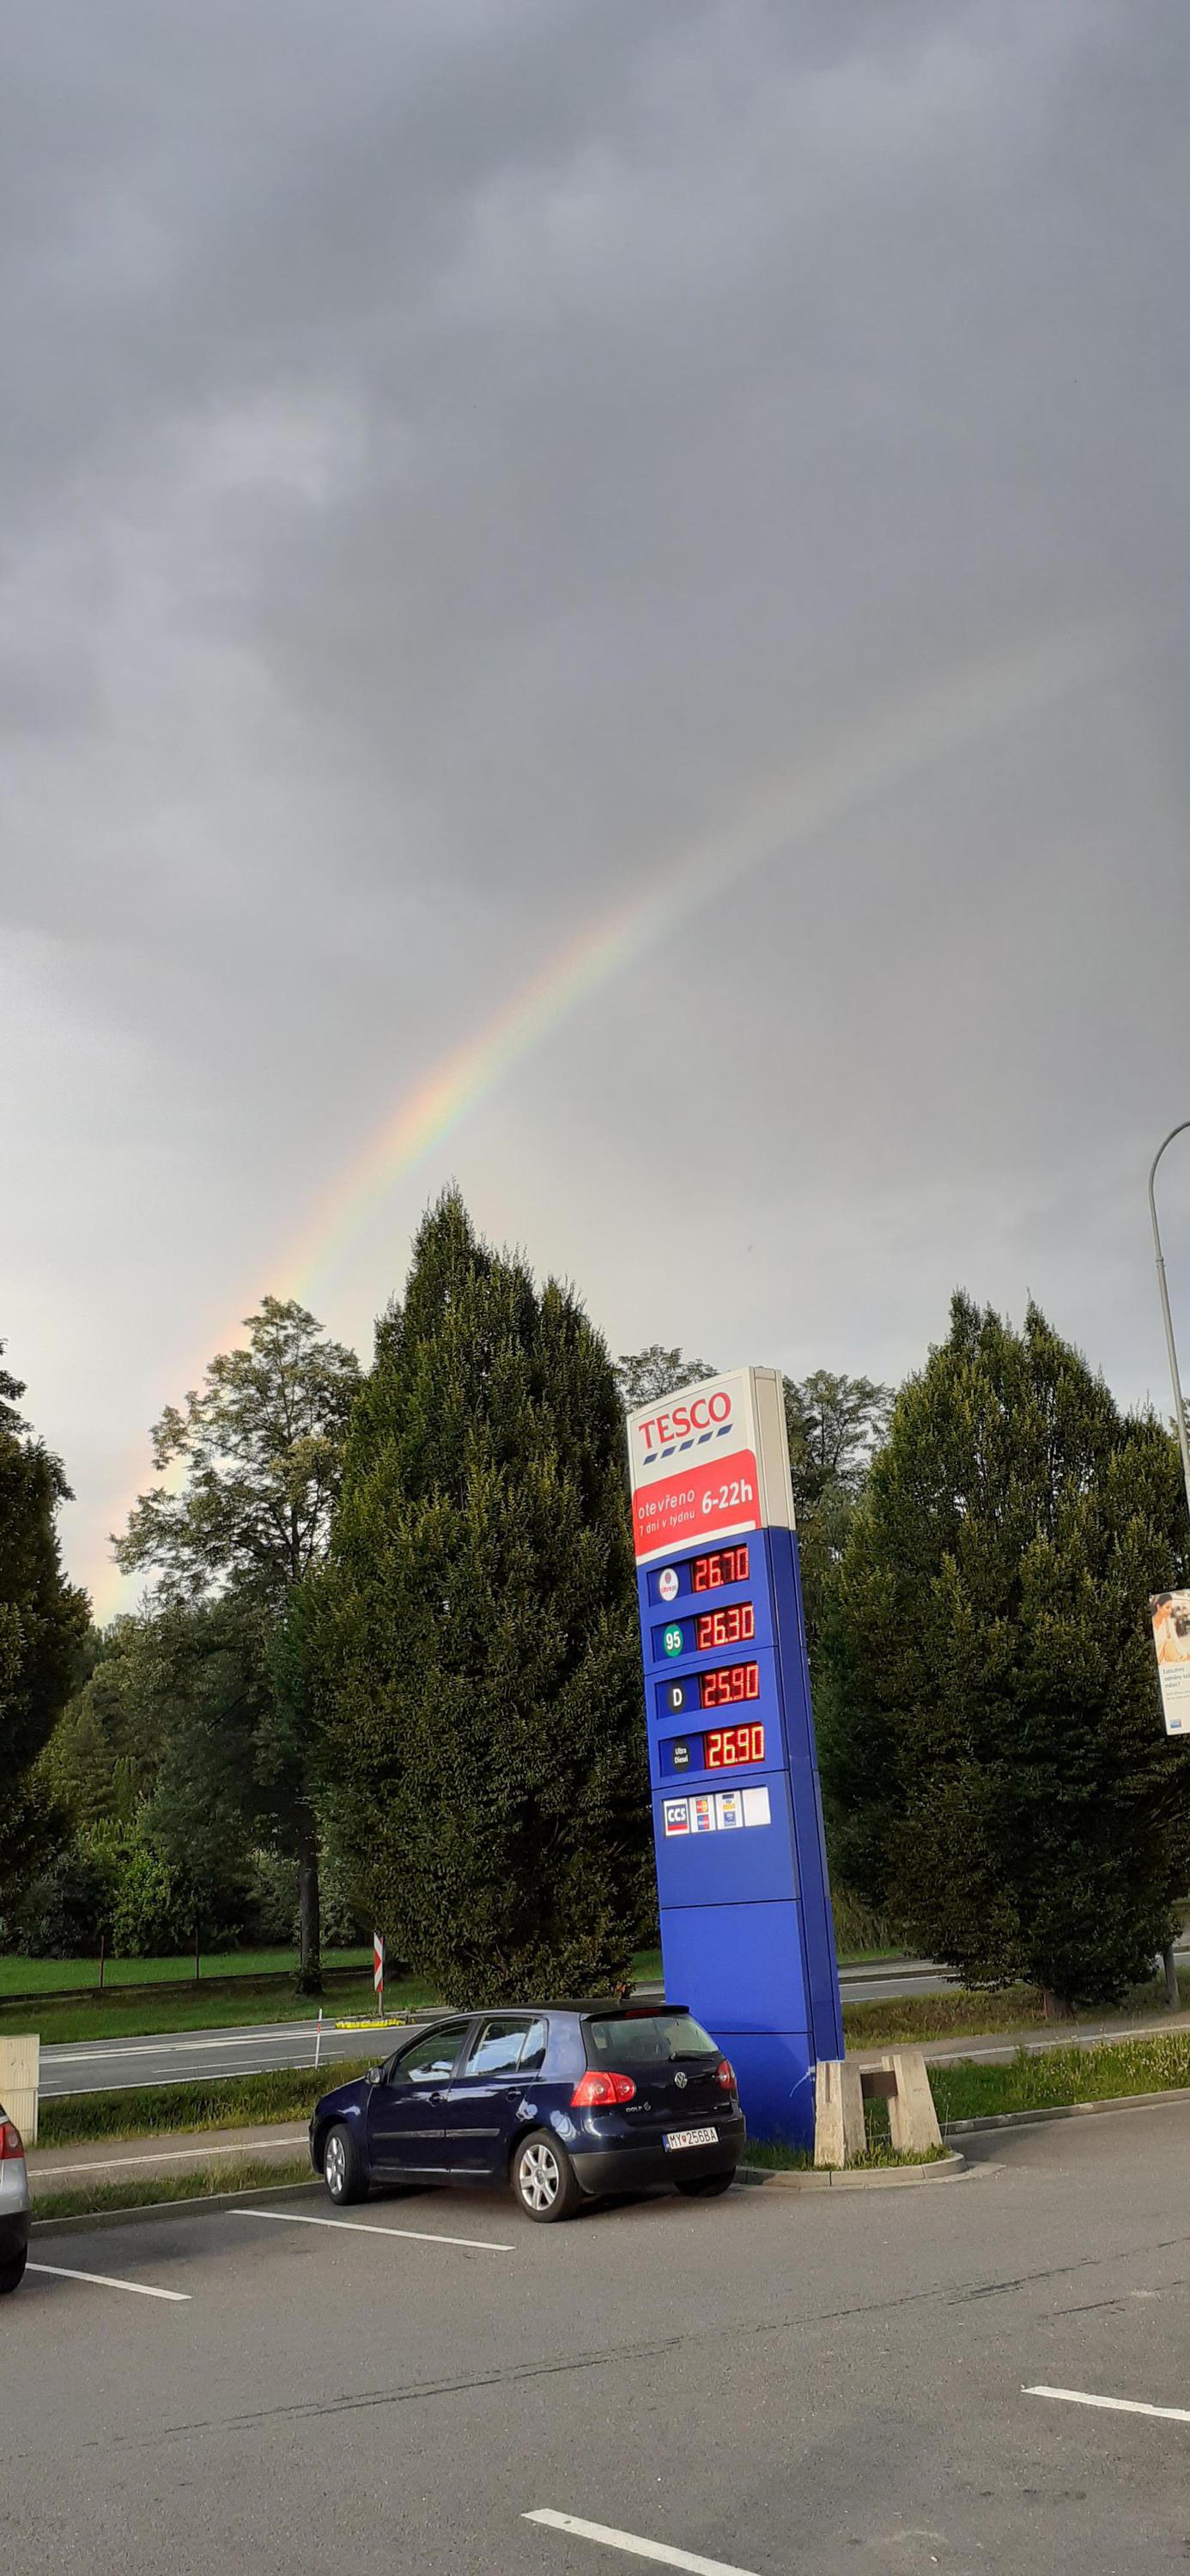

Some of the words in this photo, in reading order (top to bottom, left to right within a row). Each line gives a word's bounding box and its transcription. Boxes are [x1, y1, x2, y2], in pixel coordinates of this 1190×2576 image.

[639, 1392, 732, 1449] TESCO
[638, 1489, 695, 1520] otevřeno
[701, 1479, 753, 1515] 6-22h
[695, 1547, 750, 1591] 26.70
[665, 1630, 682, 1650] 95
[700, 1605, 755, 1649] 26.30
[672, 1687, 683, 1707] D
[704, 1664, 759, 1707] 25.90
[709, 1726, 764, 1767] 26.90
[667, 1807, 687, 1822] CCS
